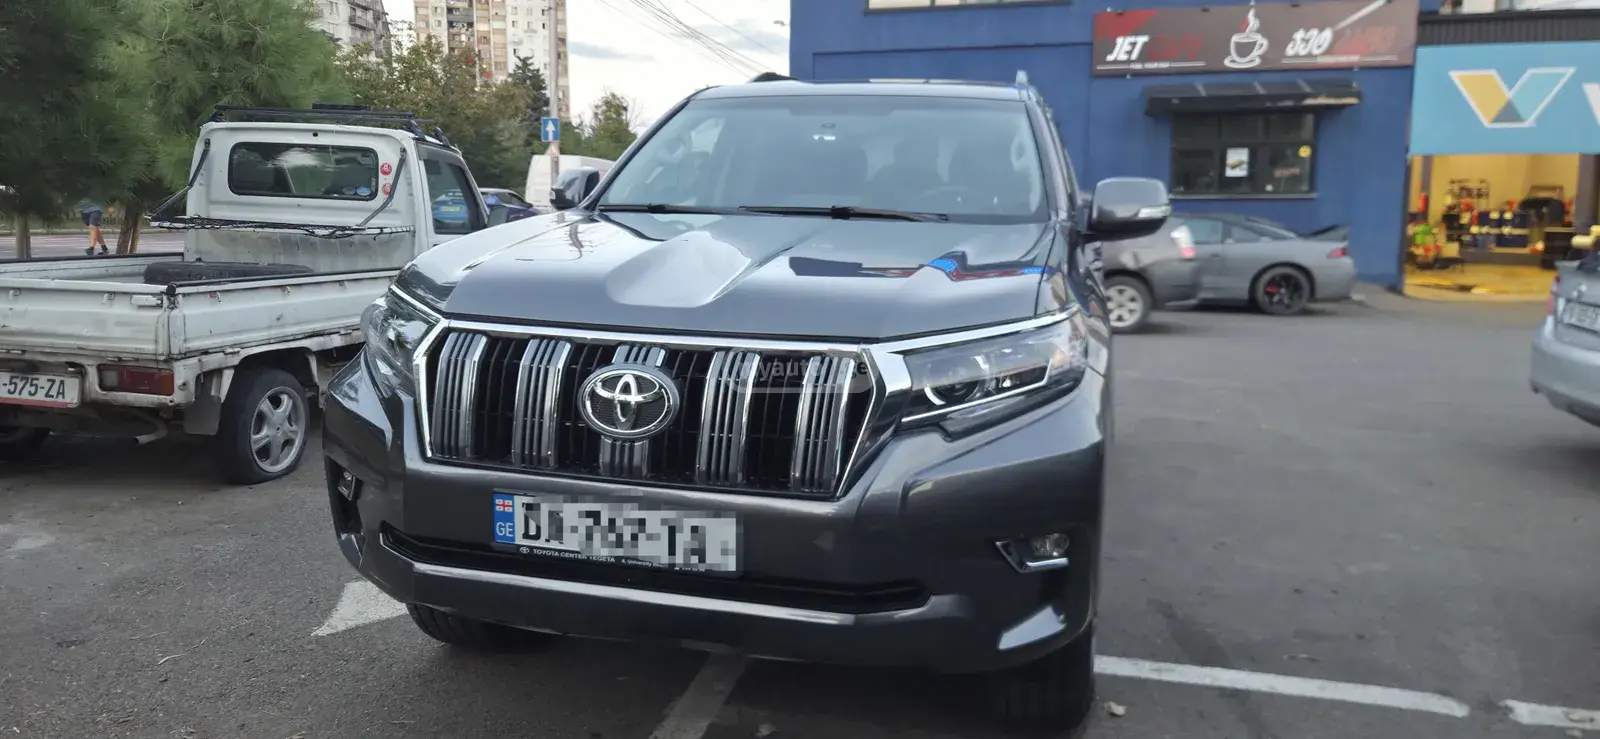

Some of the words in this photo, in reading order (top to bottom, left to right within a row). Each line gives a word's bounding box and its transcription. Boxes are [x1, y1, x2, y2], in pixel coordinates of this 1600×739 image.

[1105, 35, 1151, 62] JET
[495, 521, 515, 538] GE
[532, 548, 560, 558] TOYOTA
